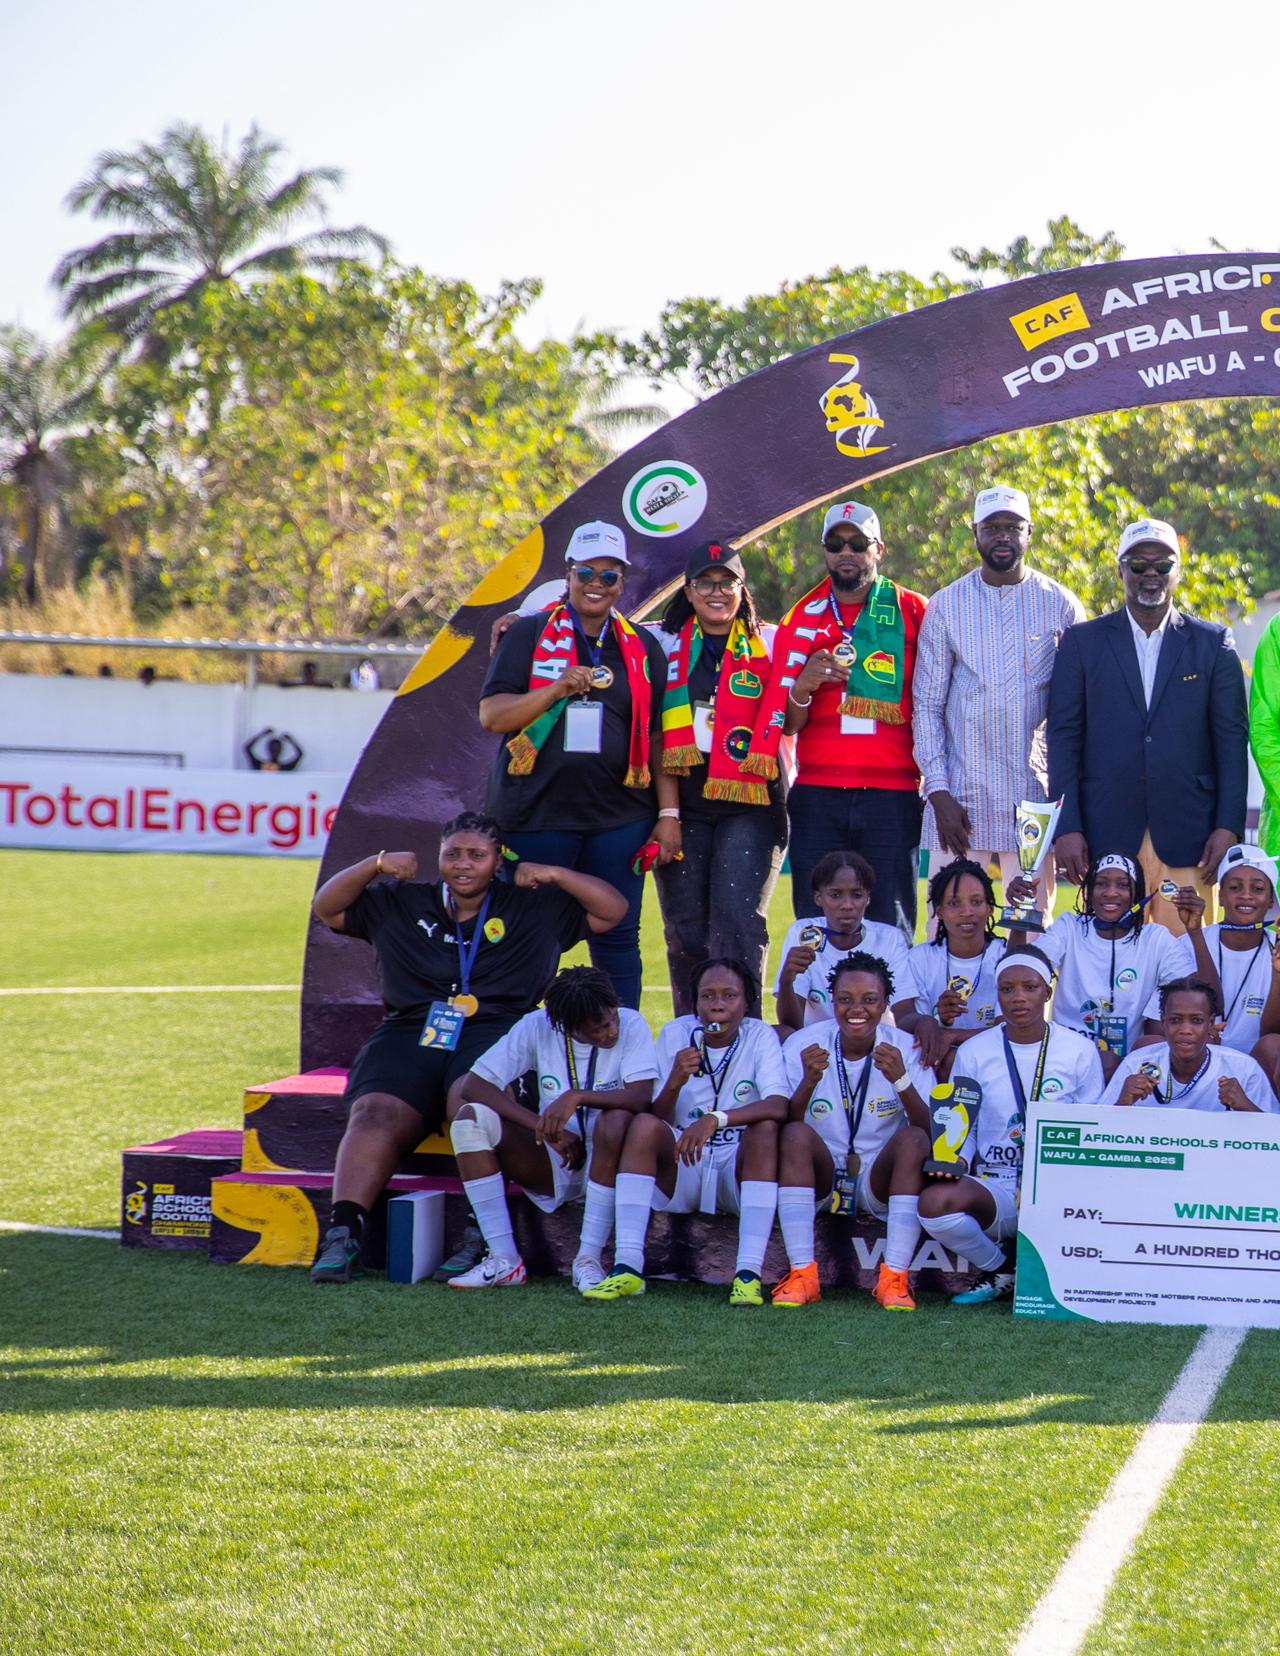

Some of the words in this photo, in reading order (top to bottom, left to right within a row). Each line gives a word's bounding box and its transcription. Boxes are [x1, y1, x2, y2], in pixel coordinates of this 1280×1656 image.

[1024, 305, 1074, 334] CAF
[1002, 310, 1248, 399] FOOTBALL
[1138, 353, 1217, 388] WAFU
[1226, 350, 1246, 372] A
[1047, 1130, 1076, 1140] CAF
[1083, 1133, 1145, 1145] AFRICAN
[1149, 1136, 1219, 1149] SCHOOLS
[1043, 1150, 1075, 1159] WAFU
[1078, 1152, 1087, 1160] A
[1098, 1153, 1142, 1163] GAMBIA
[1144, 1156, 1176, 1165] 2025
[1063, 1207, 1103, 1221] PAY:
[1061, 1246, 1103, 1260] USD:
[1135, 1243, 1147, 1254] A
[1154, 1244, 1240, 1259] HUNDRED
[1064, 1296, 1116, 1304] DEVELOPMENT
[1118, 1298, 1156, 1306] PROJECTS
[1073, 1289, 1123, 1297] PARTNERSHIP
[1197, 1295, 1243, 1303] FOUNDATION
